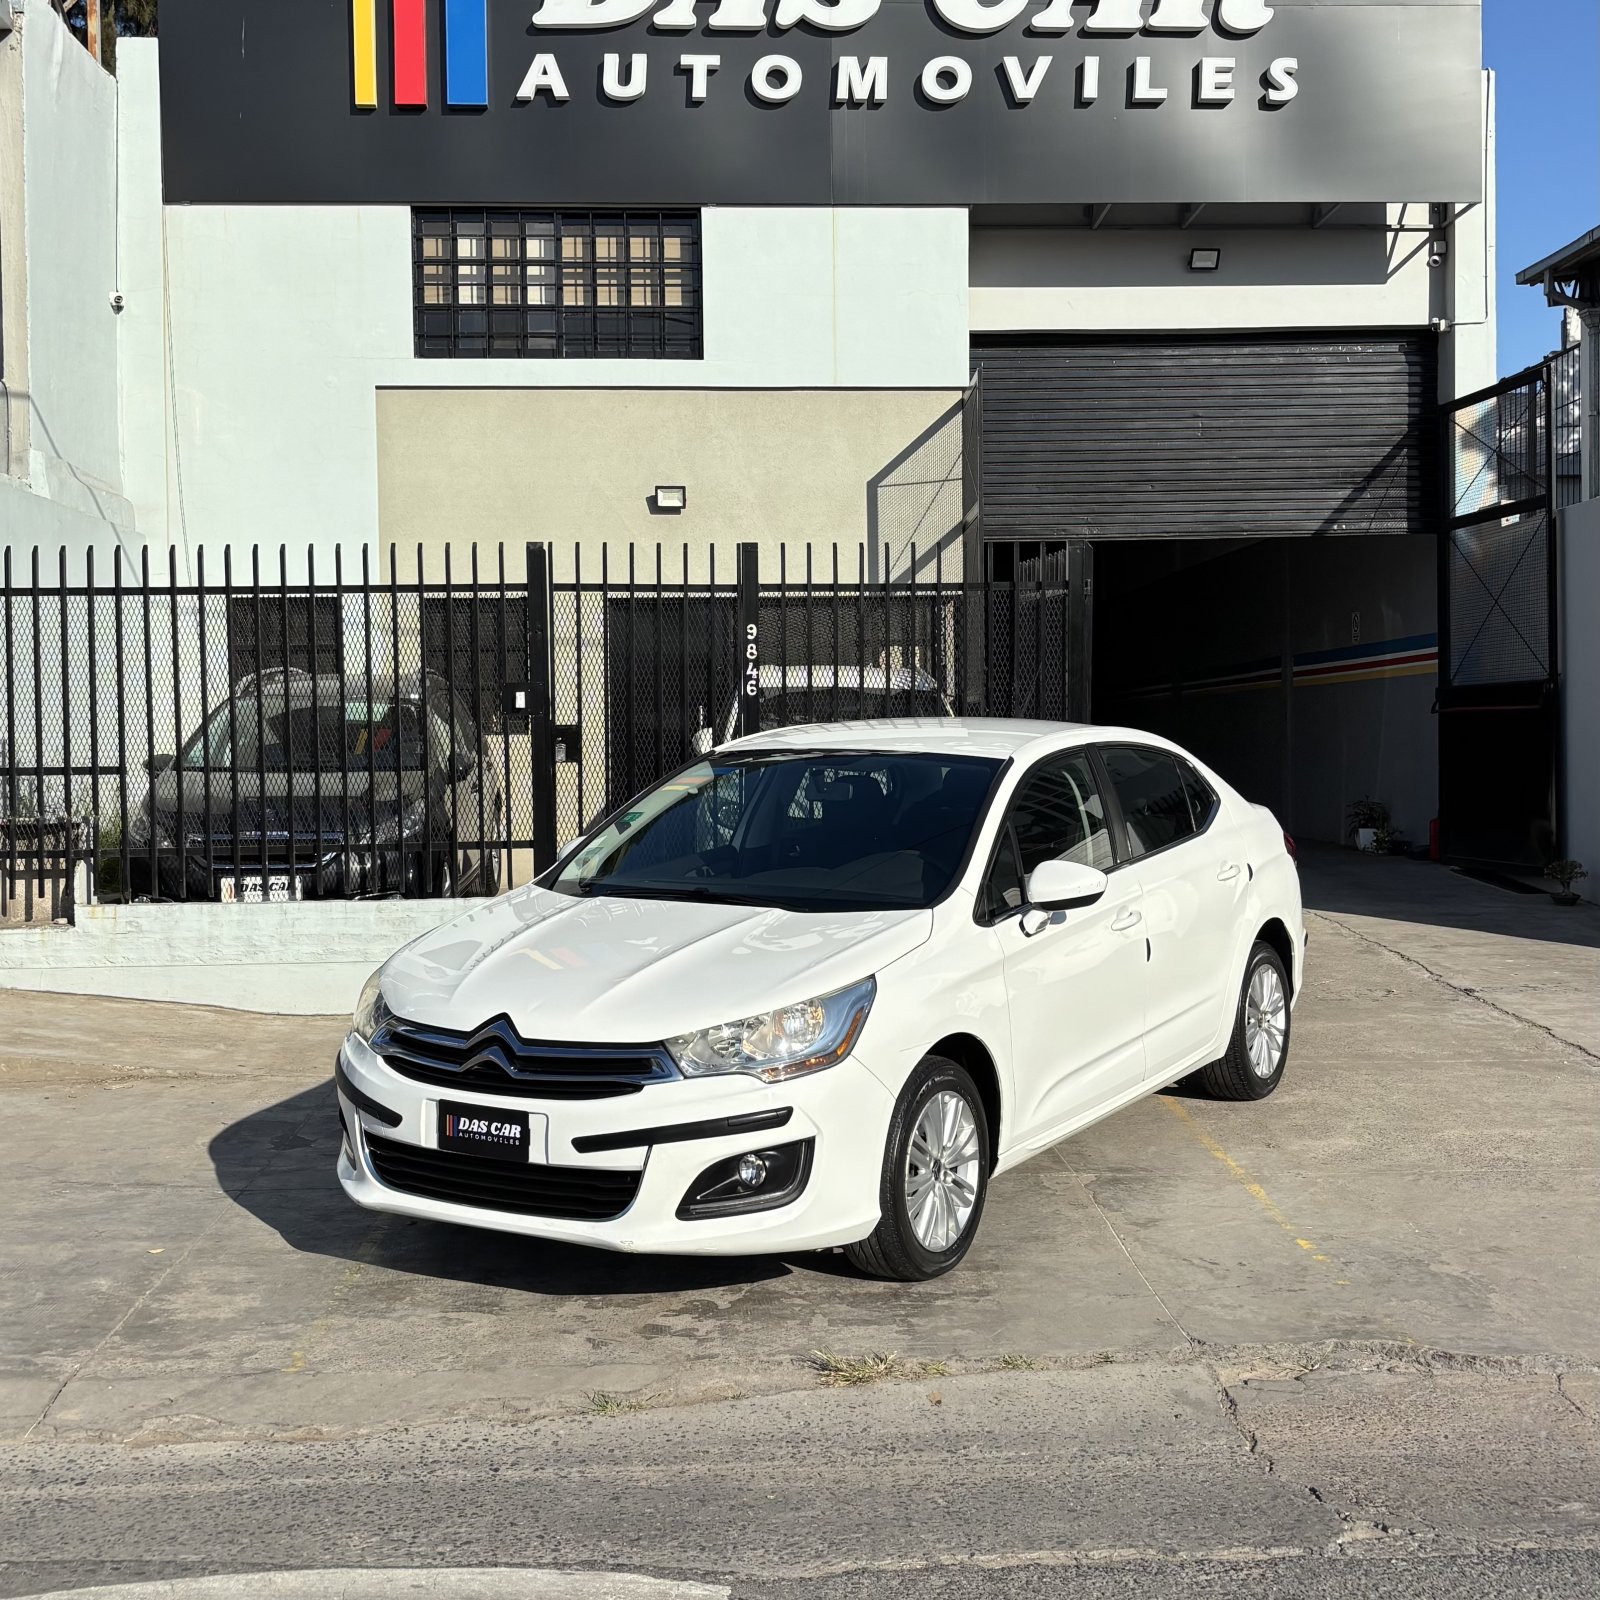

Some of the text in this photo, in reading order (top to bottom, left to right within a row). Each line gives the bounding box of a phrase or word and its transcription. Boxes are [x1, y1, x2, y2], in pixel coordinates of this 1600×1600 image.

[515, 53, 1299, 104] AUTOMOVILES
[746, 623, 758, 696] 9846
[459, 1117, 521, 1138] DAS CAR
[459, 1132, 520, 1145] AUTOMOVILES
